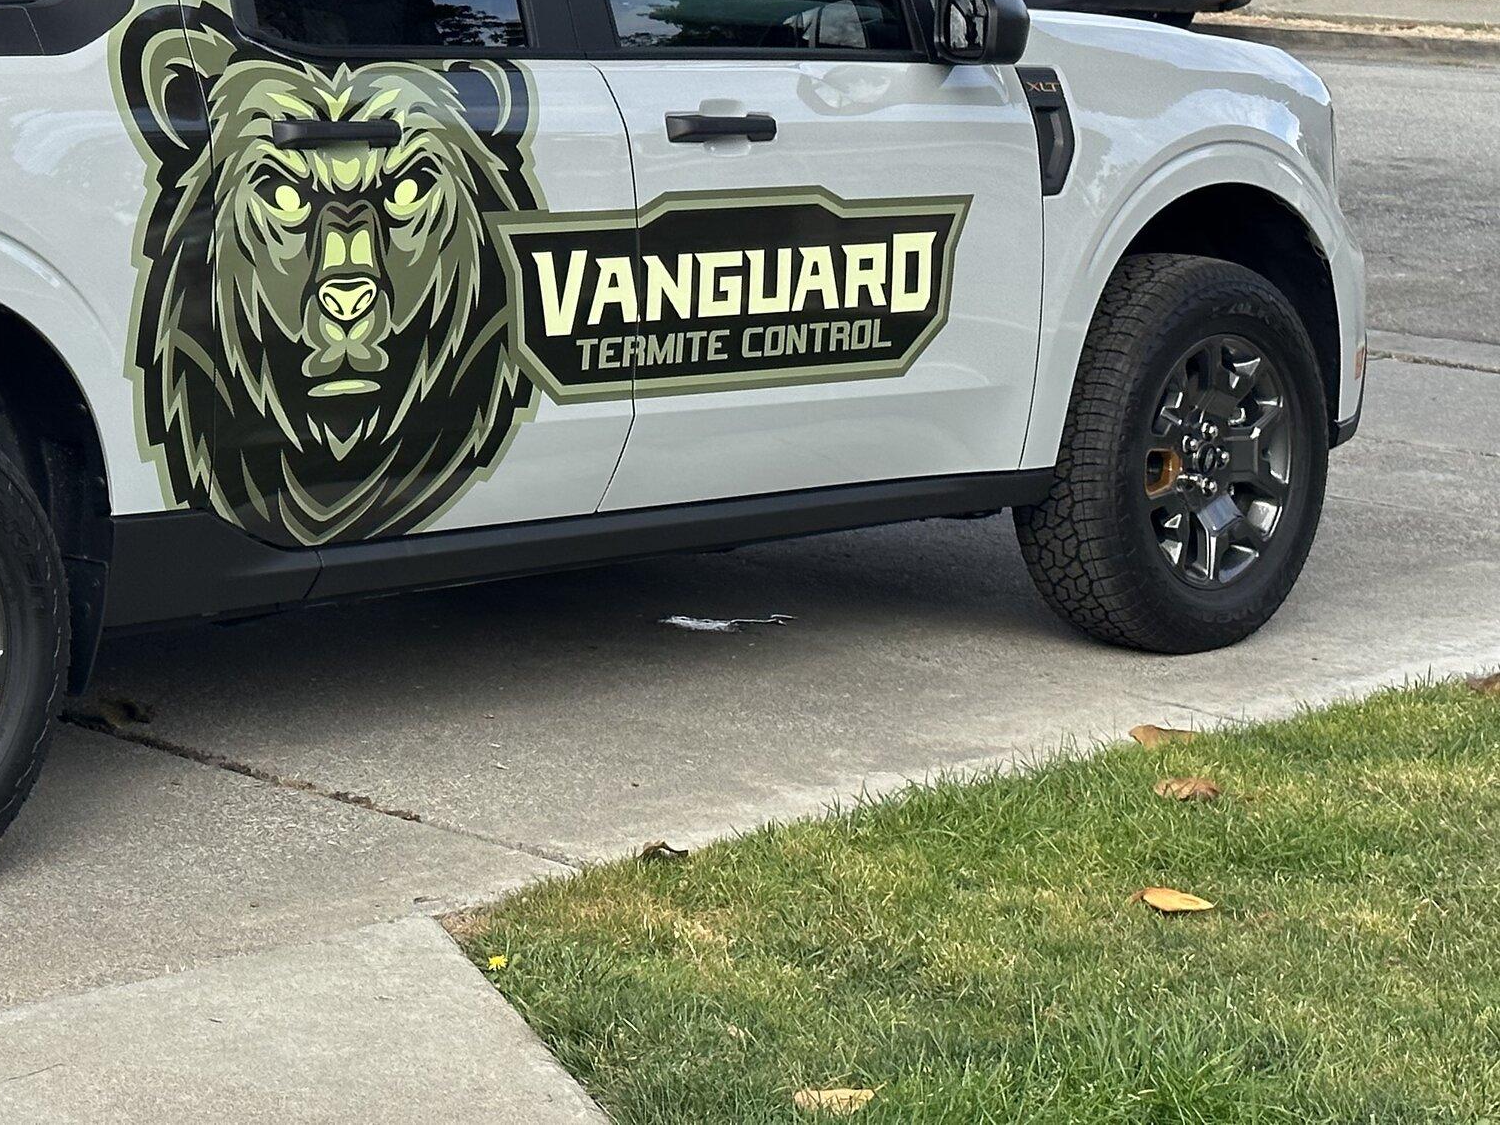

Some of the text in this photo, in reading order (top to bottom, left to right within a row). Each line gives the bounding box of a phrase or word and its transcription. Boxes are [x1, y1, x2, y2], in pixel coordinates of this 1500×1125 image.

[1025, 81, 1060, 93] XLT
[531, 230, 938, 338] VANGUARD
[575, 318, 893, 371] TERMITE CONTROL
